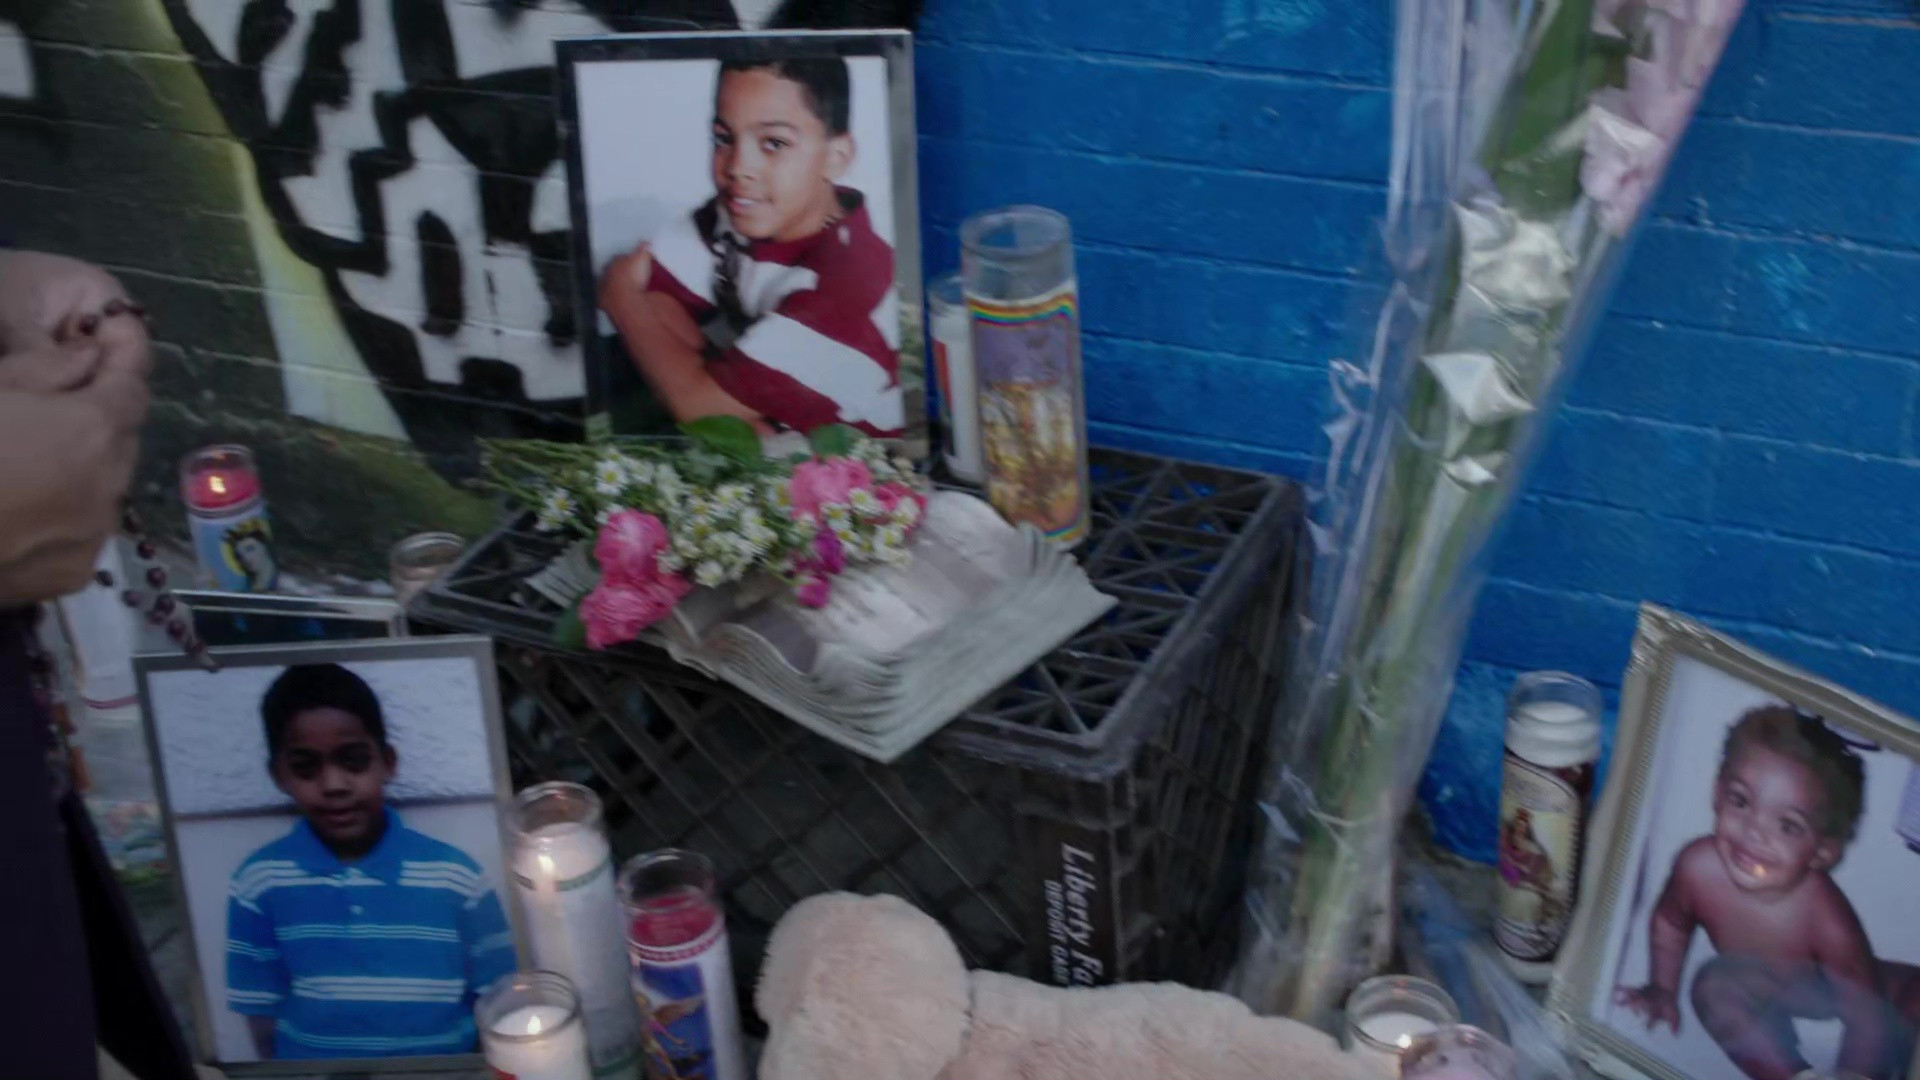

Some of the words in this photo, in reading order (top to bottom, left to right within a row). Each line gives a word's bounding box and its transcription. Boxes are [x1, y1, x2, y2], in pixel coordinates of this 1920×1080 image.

[1044, 879, 1068, 945] DEPOSIT
[1060, 842, 1096, 947] Liberty
[1070, 949, 1103, 984] Fa
